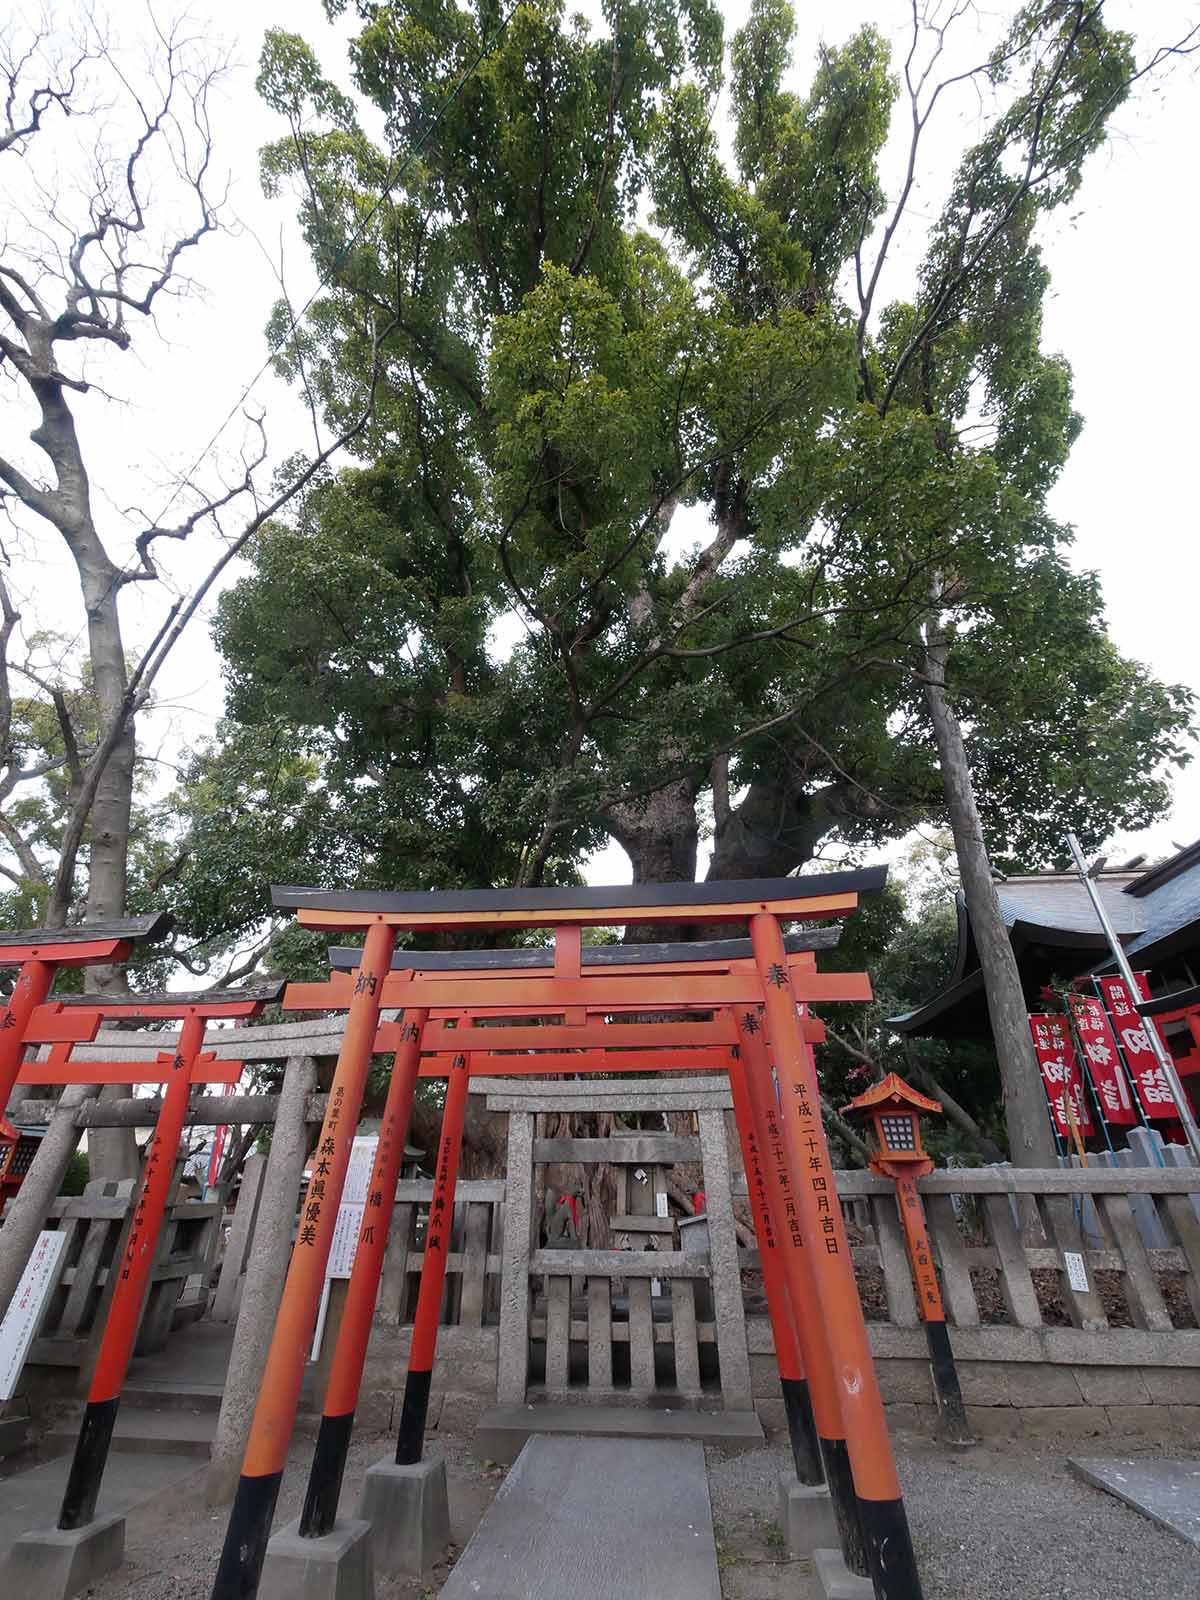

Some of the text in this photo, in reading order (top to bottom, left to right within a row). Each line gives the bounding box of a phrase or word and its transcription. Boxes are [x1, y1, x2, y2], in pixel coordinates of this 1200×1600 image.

[354, 972, 377, 996] 納
[766, 964, 789, 988] 奉
[400, 1022, 421, 1044] 納
[741, 1012, 761, 1034] 奉
[765, 1110, 802, 1247] 平成二十二年二月吉日
[793, 1084, 839, 1254] 平成二十年四月吉日
